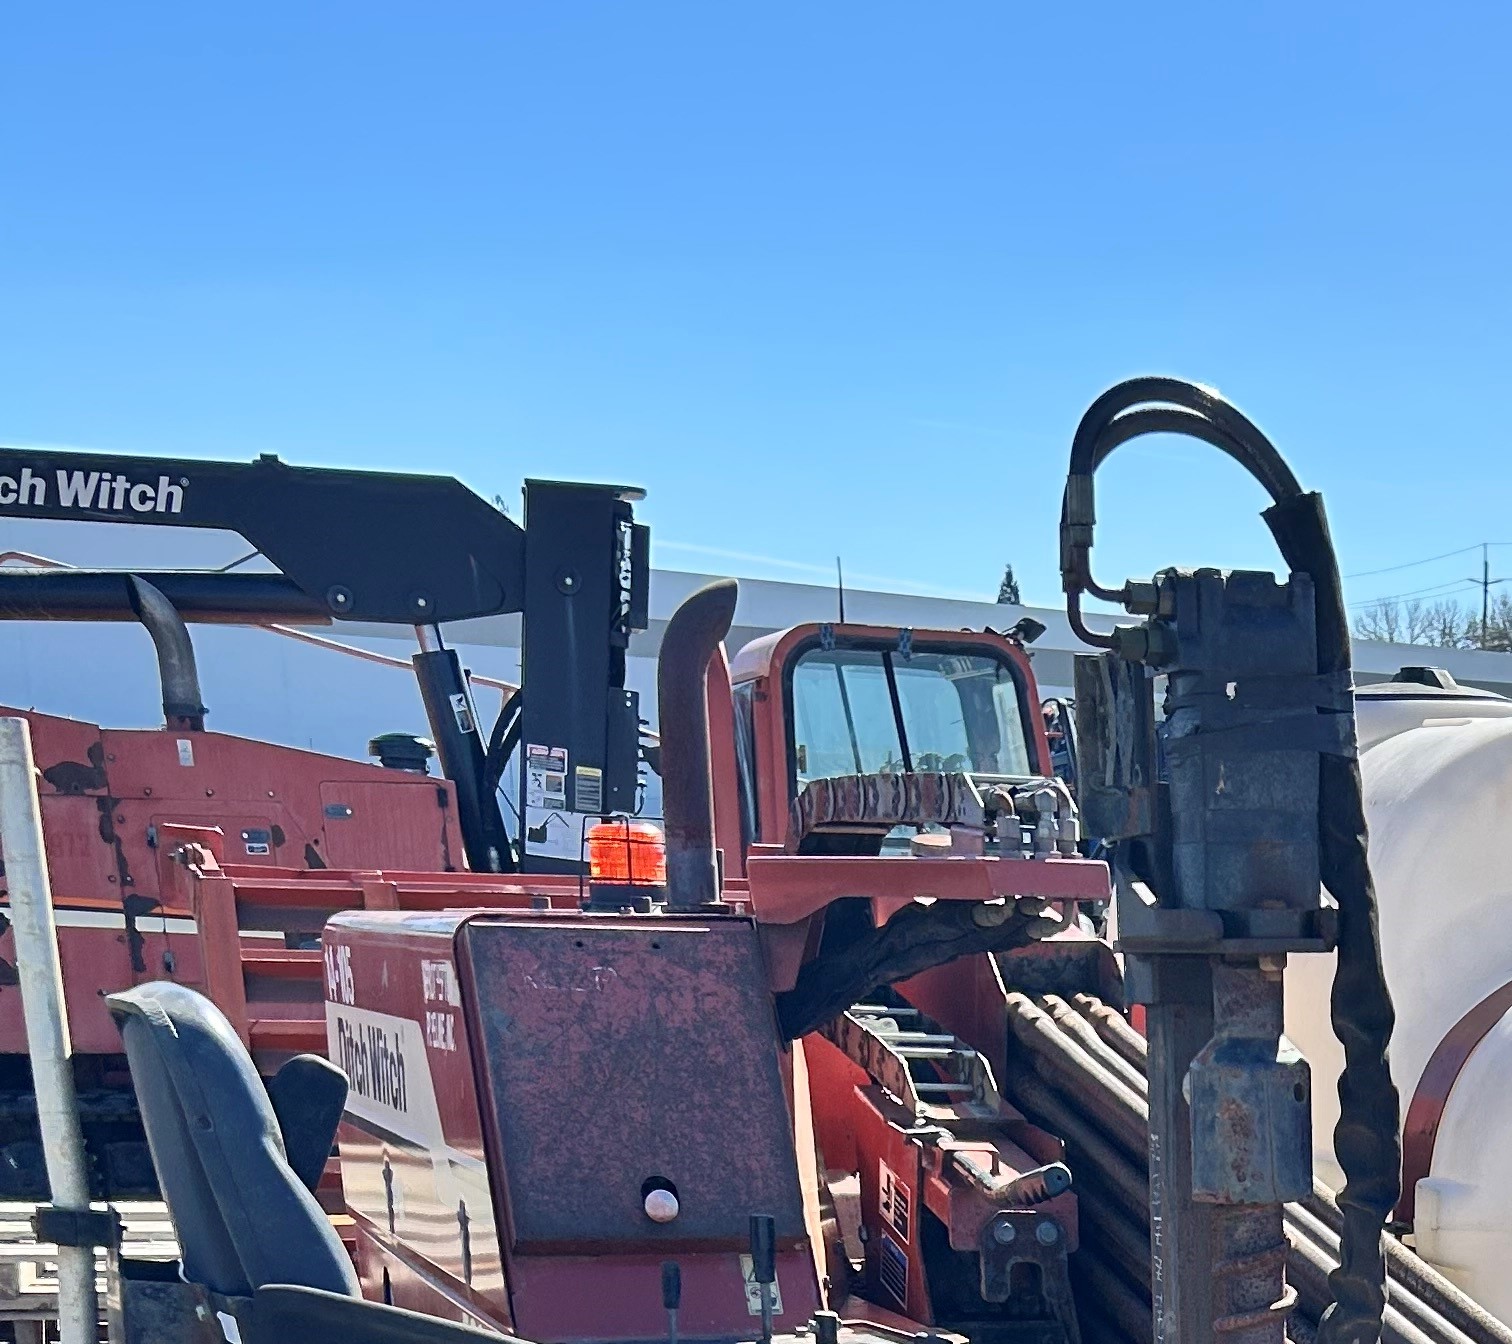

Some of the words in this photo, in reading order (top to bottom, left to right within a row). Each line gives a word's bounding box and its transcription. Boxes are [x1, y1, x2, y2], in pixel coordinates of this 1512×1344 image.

[56, 469, 184, 514] Witch
[337, 1017, 370, 1099] Ditch
[367, 1024, 408, 1113] Witch
